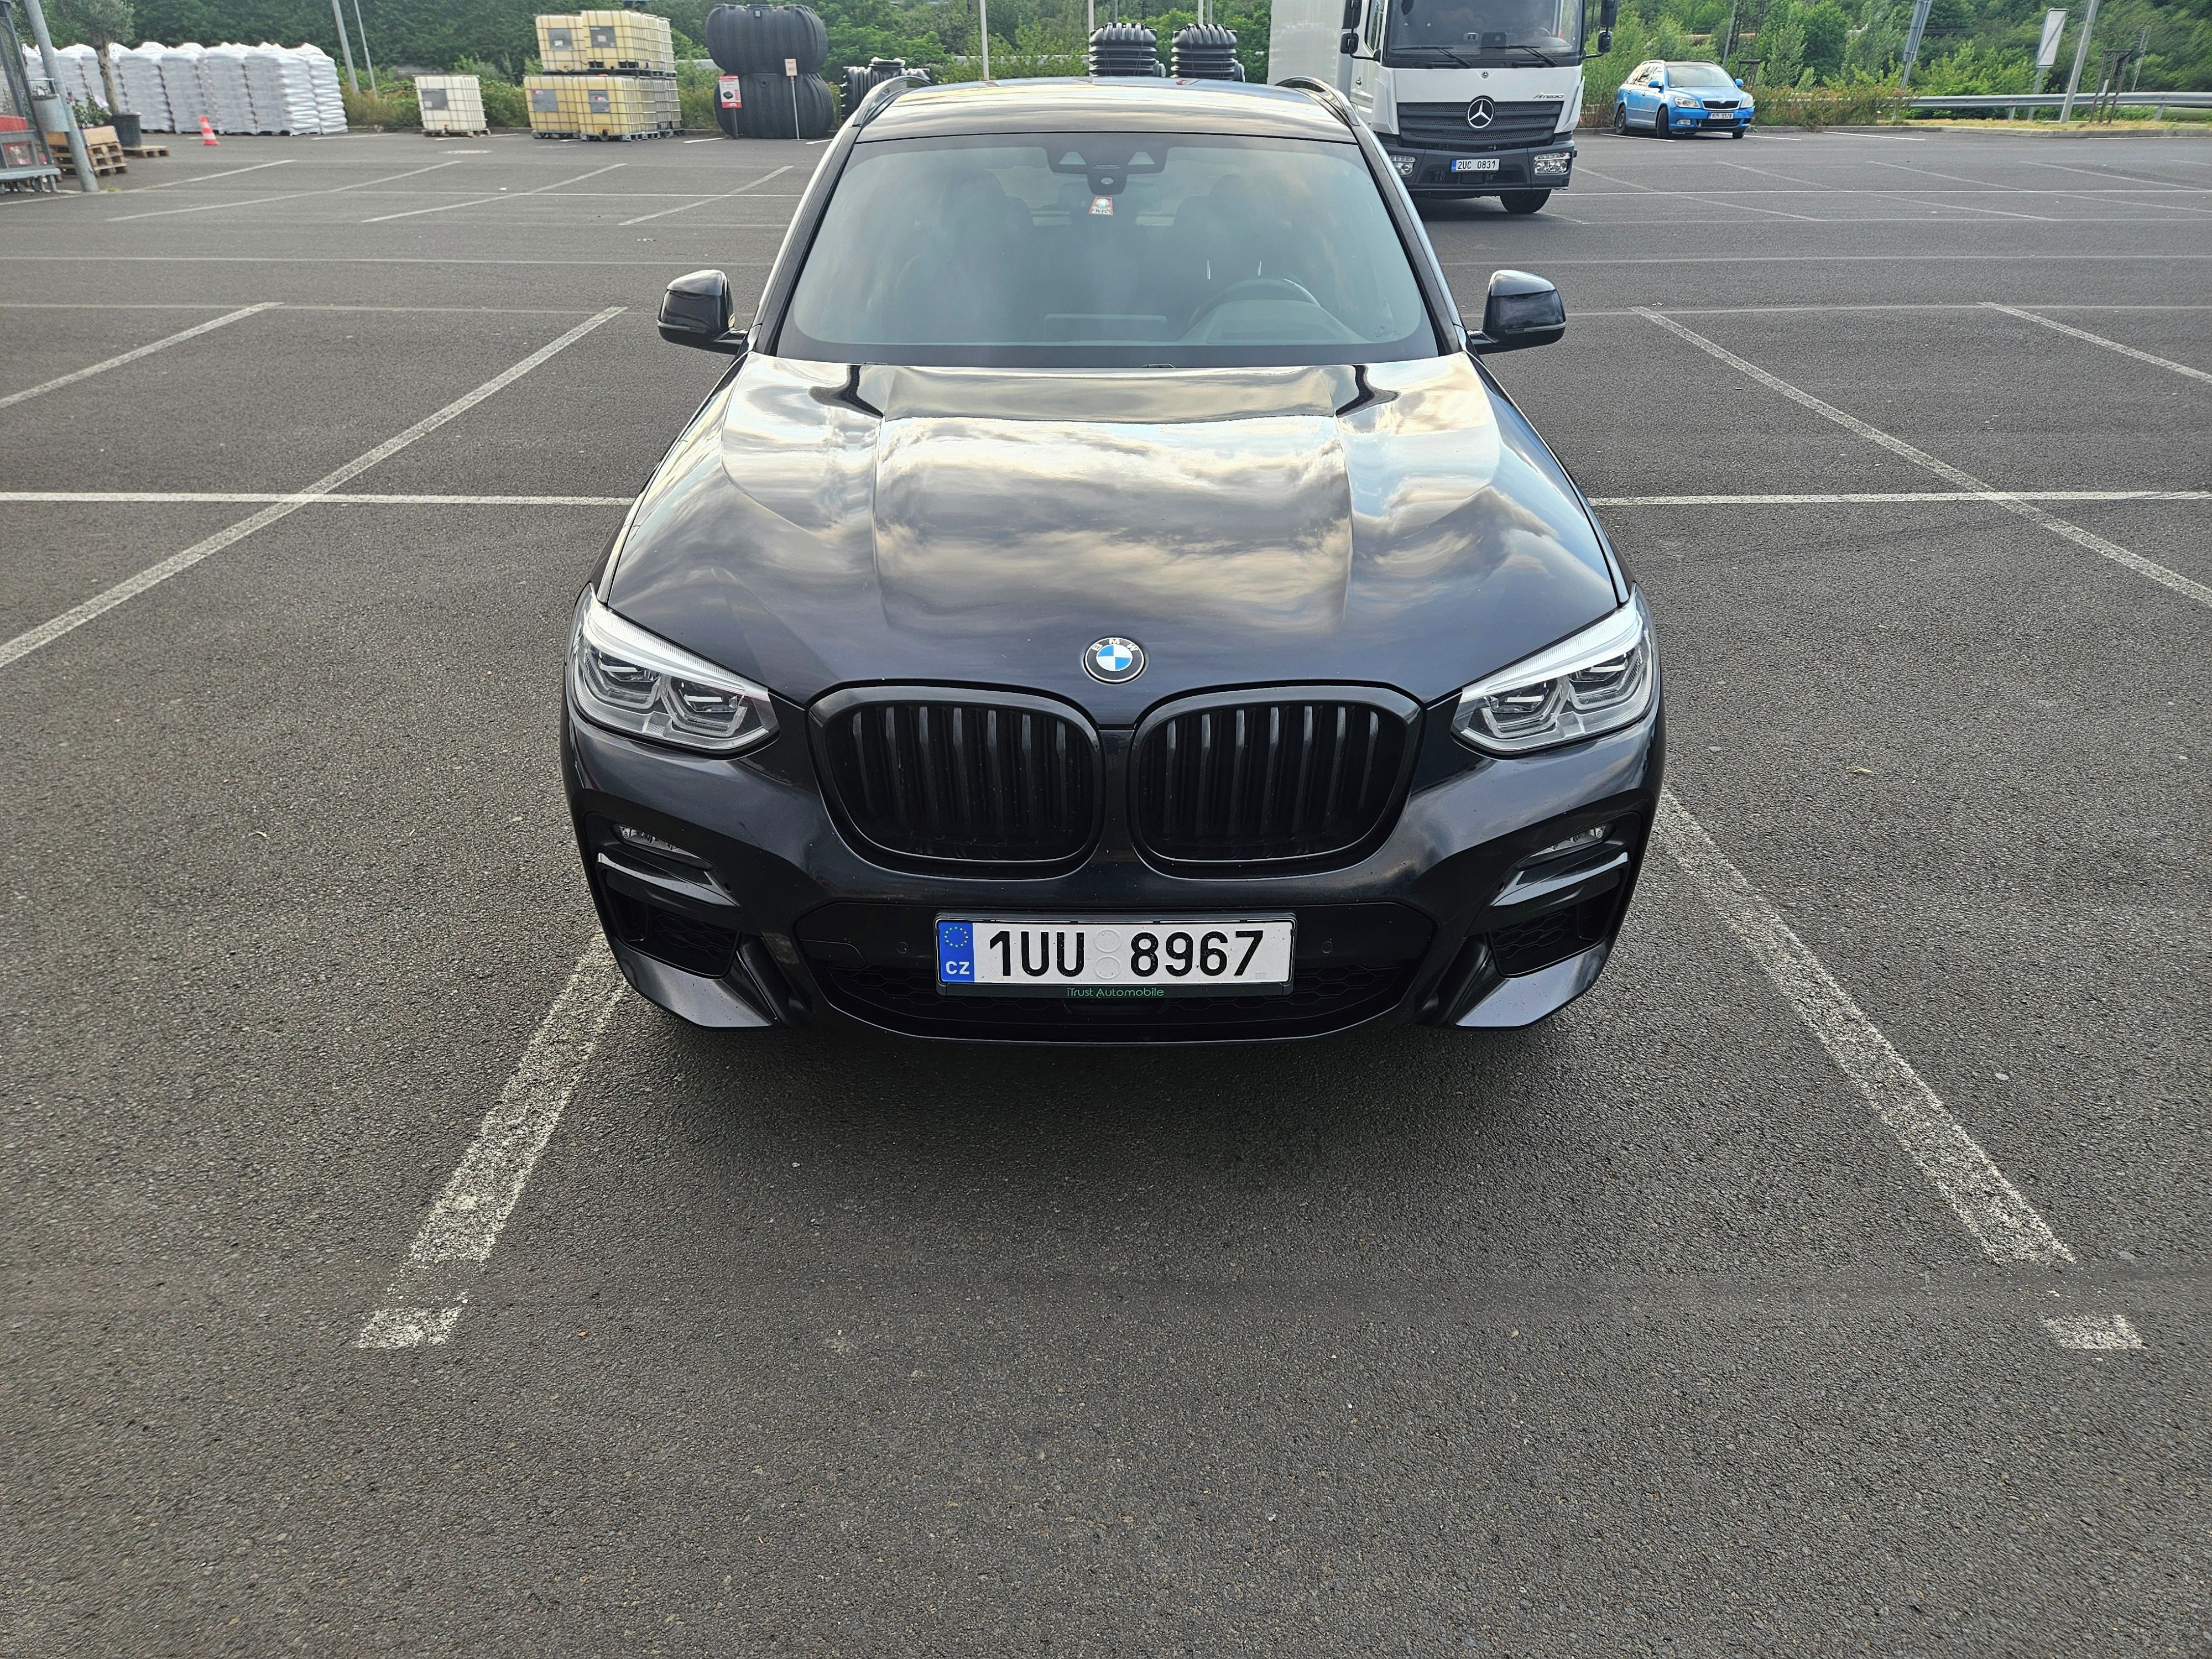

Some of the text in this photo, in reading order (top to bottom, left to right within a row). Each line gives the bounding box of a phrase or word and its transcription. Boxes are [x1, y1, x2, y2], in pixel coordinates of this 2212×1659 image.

[1458, 160, 1495, 169] 2UC 0831
[1092, 639, 1138, 651] BMW
[989, 930, 1264, 977] 1UU 8967
[946, 961, 970, 975] CZ
[1067, 988, 1164, 997] iTrust Automobile
